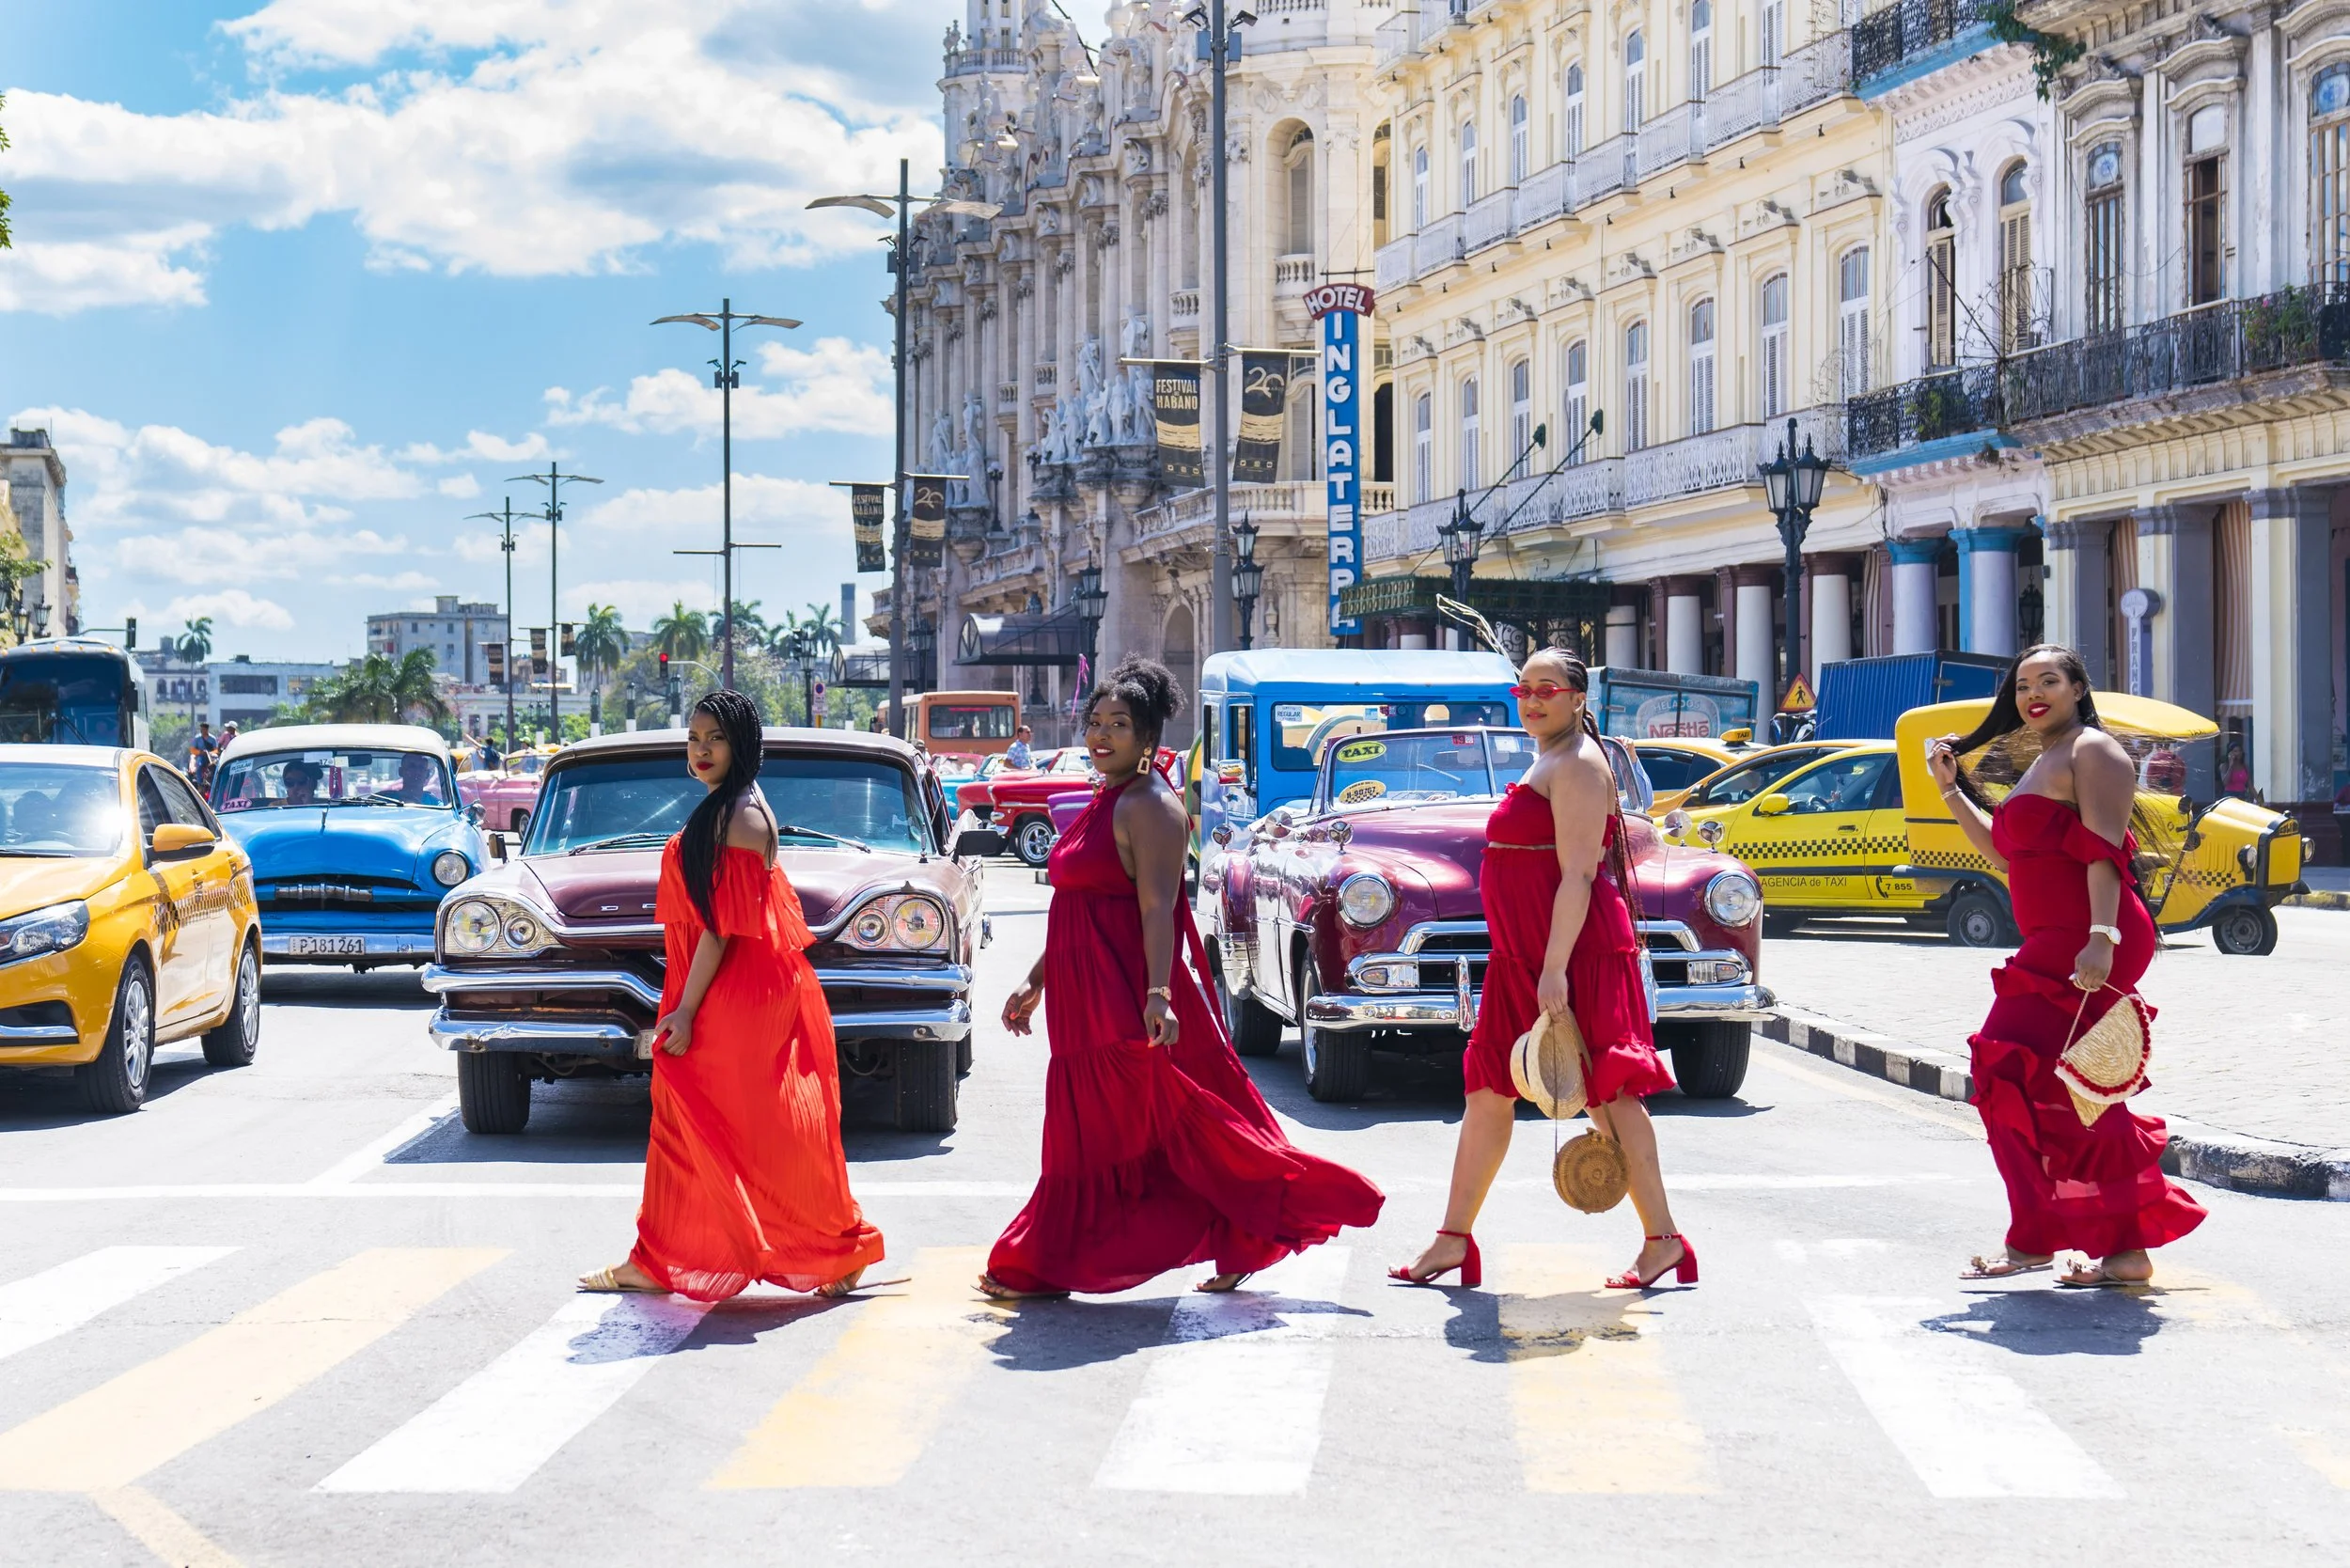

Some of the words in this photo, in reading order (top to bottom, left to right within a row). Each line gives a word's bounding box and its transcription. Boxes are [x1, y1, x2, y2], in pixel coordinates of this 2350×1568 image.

[1305, 286, 1366, 316] HOTEL
[1156, 379, 1198, 394] FESTIVAL
[1245, 366, 1285, 398] 20
[1156, 395, 1198, 410] HABANO
[853, 494, 883, 504] FESTIVAL
[915, 487, 945, 509] 20
[854, 505, 884, 516] HABANO
[1654, 699, 1700, 711] HELADOS
[1342, 745, 1380, 759] TAXI
[225, 800, 248, 810] TAXI
[1761, 876, 1807, 887] AGENCIA
[1810, 876, 1822, 887] de
[1824, 876, 1847, 887] TAXI
[1894, 883, 1913, 891] 855
